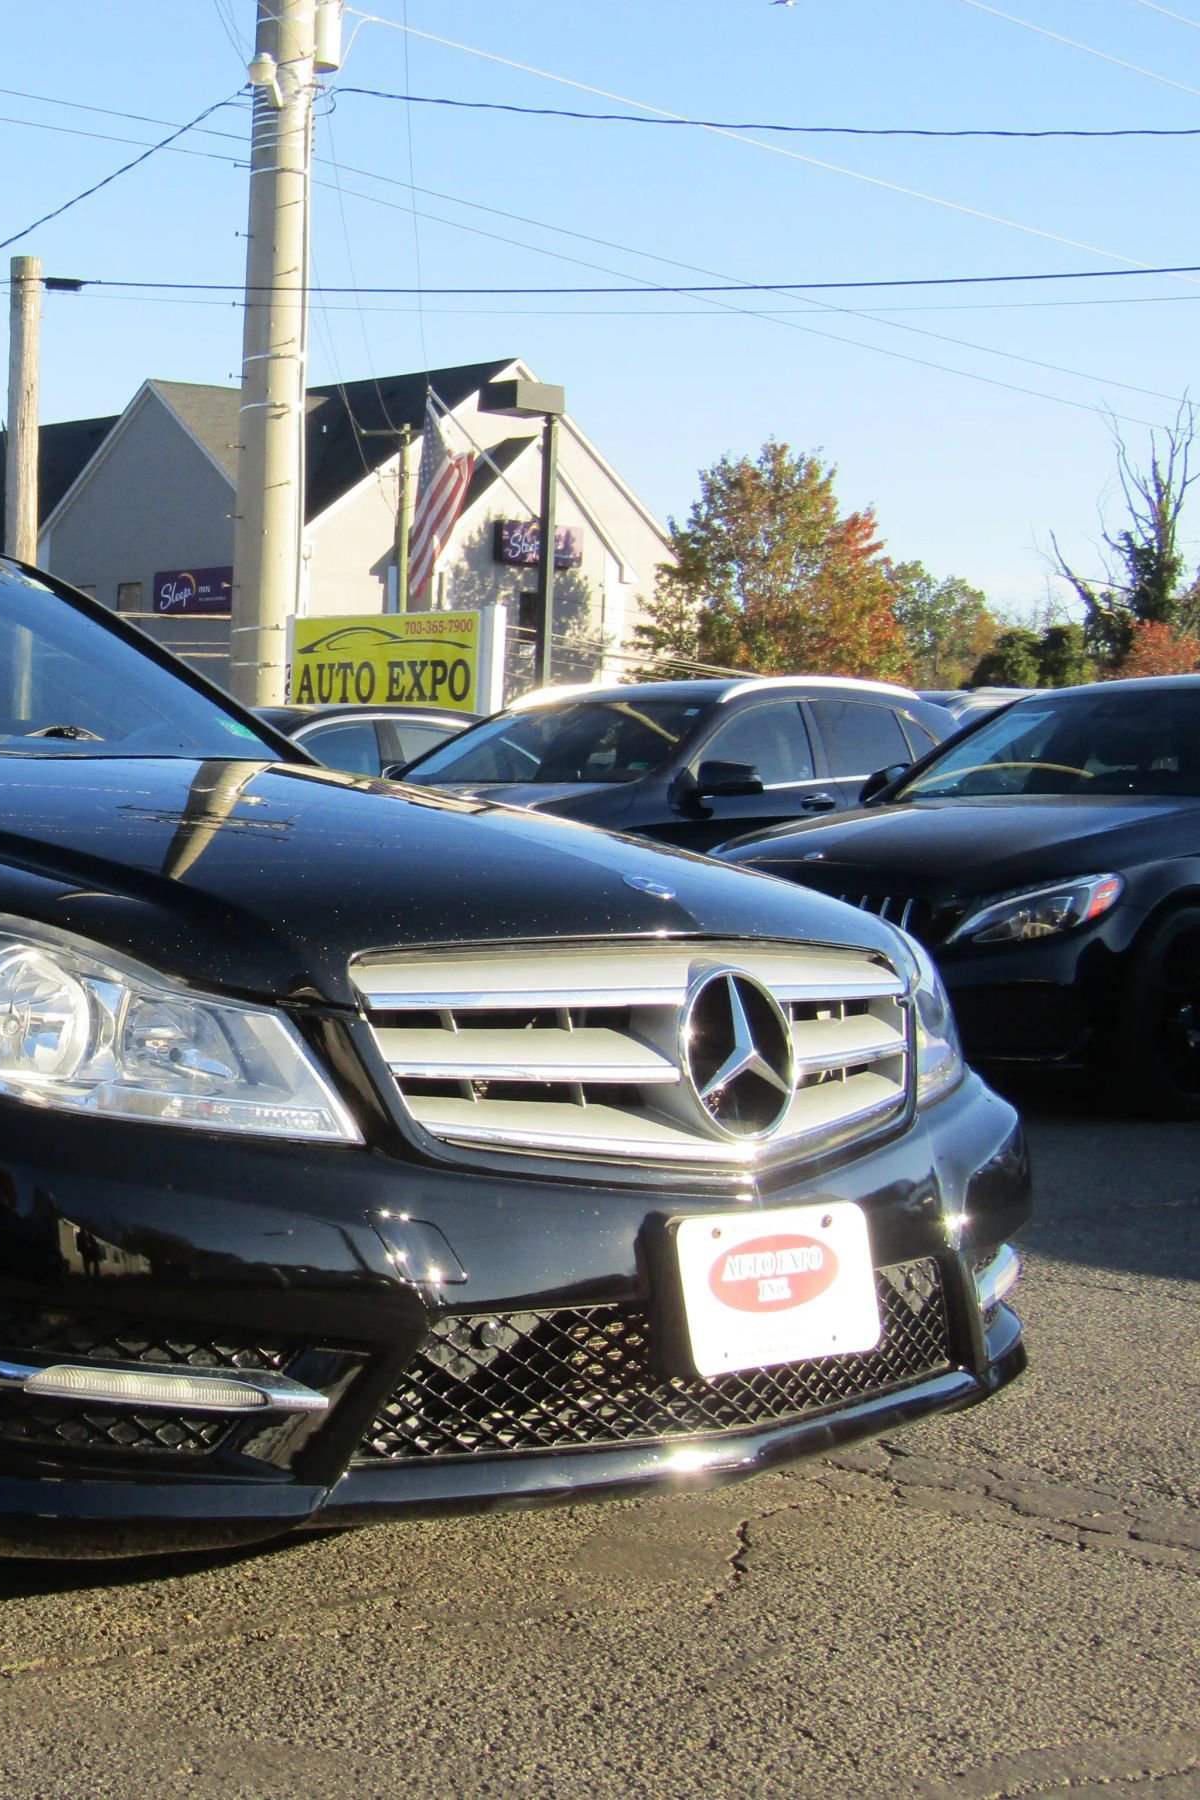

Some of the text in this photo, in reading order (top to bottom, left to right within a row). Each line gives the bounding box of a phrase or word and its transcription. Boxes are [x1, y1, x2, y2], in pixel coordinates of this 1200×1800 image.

[160, 582, 211, 610] Sleep INN
[404, 618, 473, 635] 703-365-7900
[296, 660, 375, 704] AUTO
[385, 658, 471, 703] EXPO
[722, 1245, 823, 1282] AUTO EXPO
